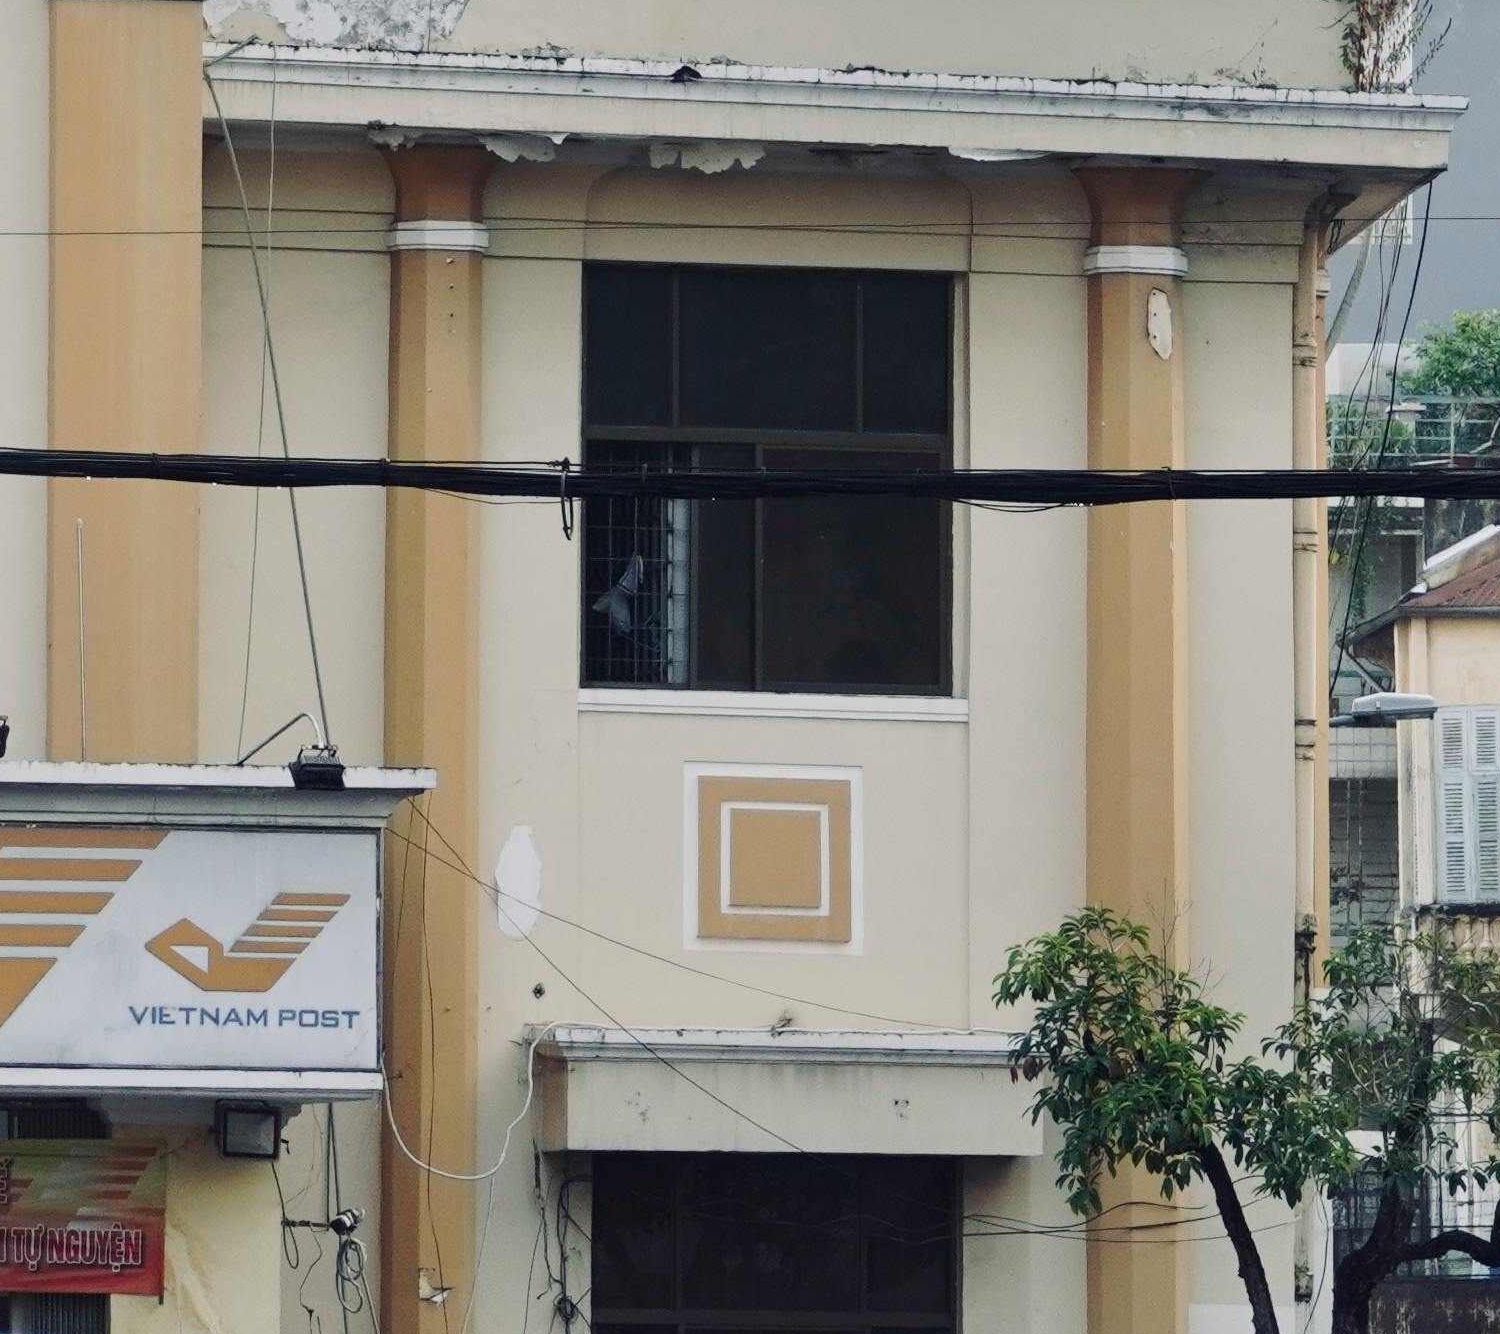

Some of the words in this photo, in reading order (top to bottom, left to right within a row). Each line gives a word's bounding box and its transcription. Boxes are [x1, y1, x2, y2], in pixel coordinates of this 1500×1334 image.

[128, 1006, 268, 1027] VIETNAM
[278, 1009, 360, 1029] POST
[11, 1226, 43, 1271] TỰ
[45, 1222, 143, 1273] NGUYỆN
